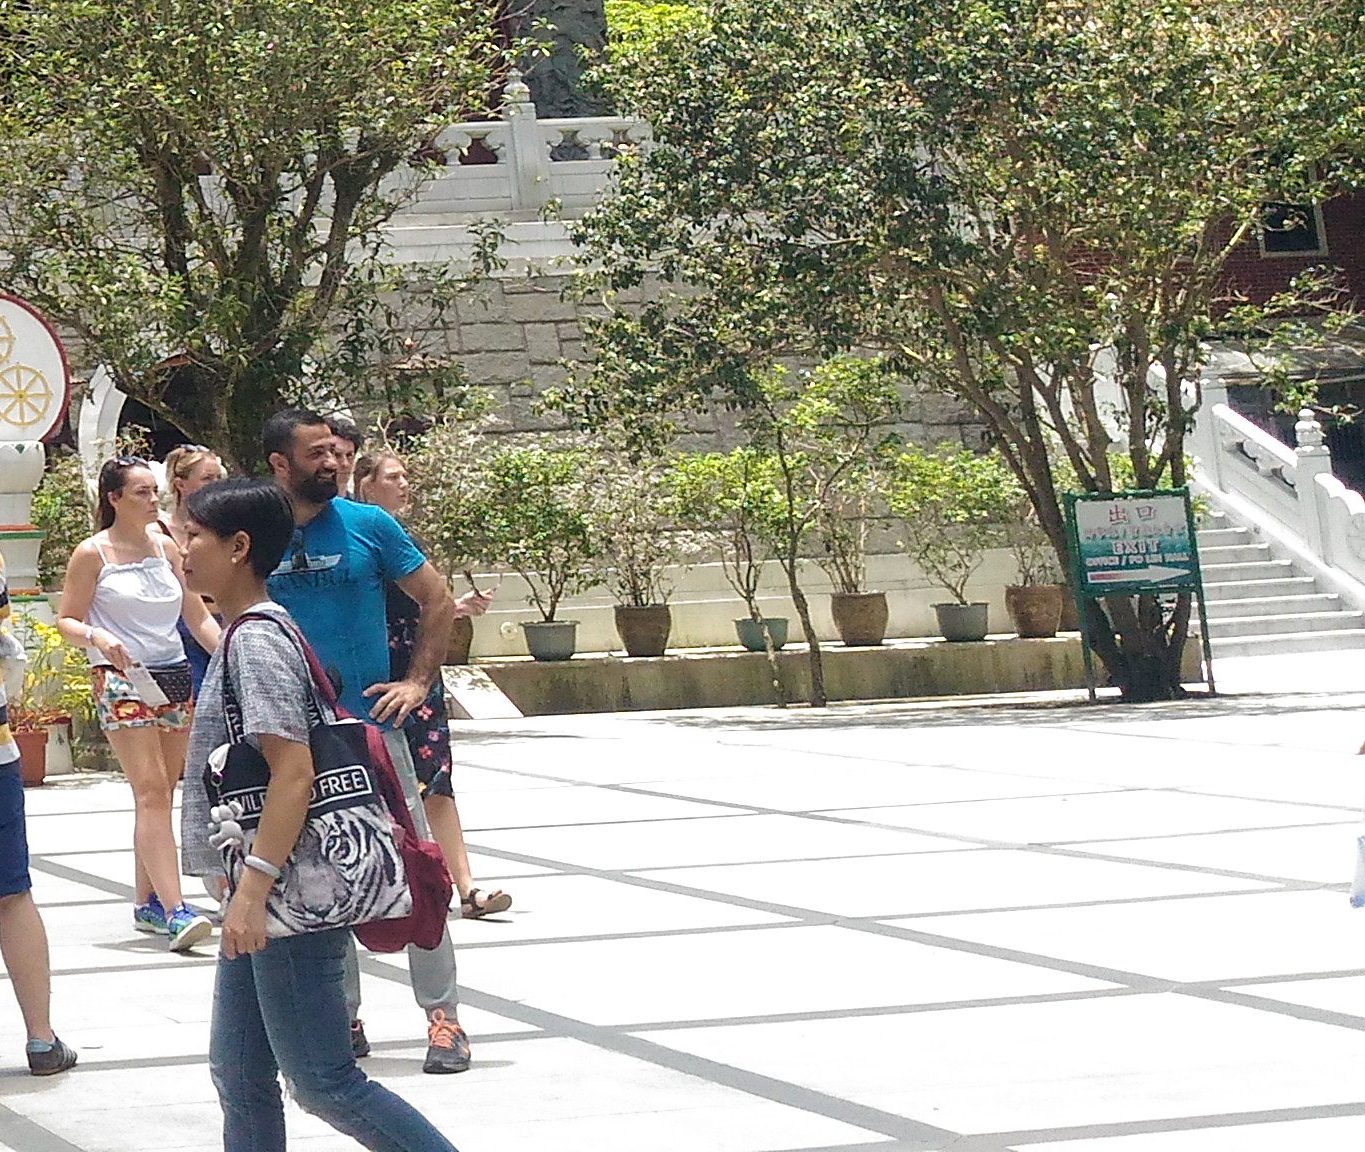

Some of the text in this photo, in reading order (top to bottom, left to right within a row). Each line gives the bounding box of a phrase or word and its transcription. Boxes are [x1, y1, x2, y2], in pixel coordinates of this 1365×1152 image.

[1108, 504, 1155, 523] 出口
[1112, 539, 1159, 554] EXIT
[320, 770, 365, 797] FREE
